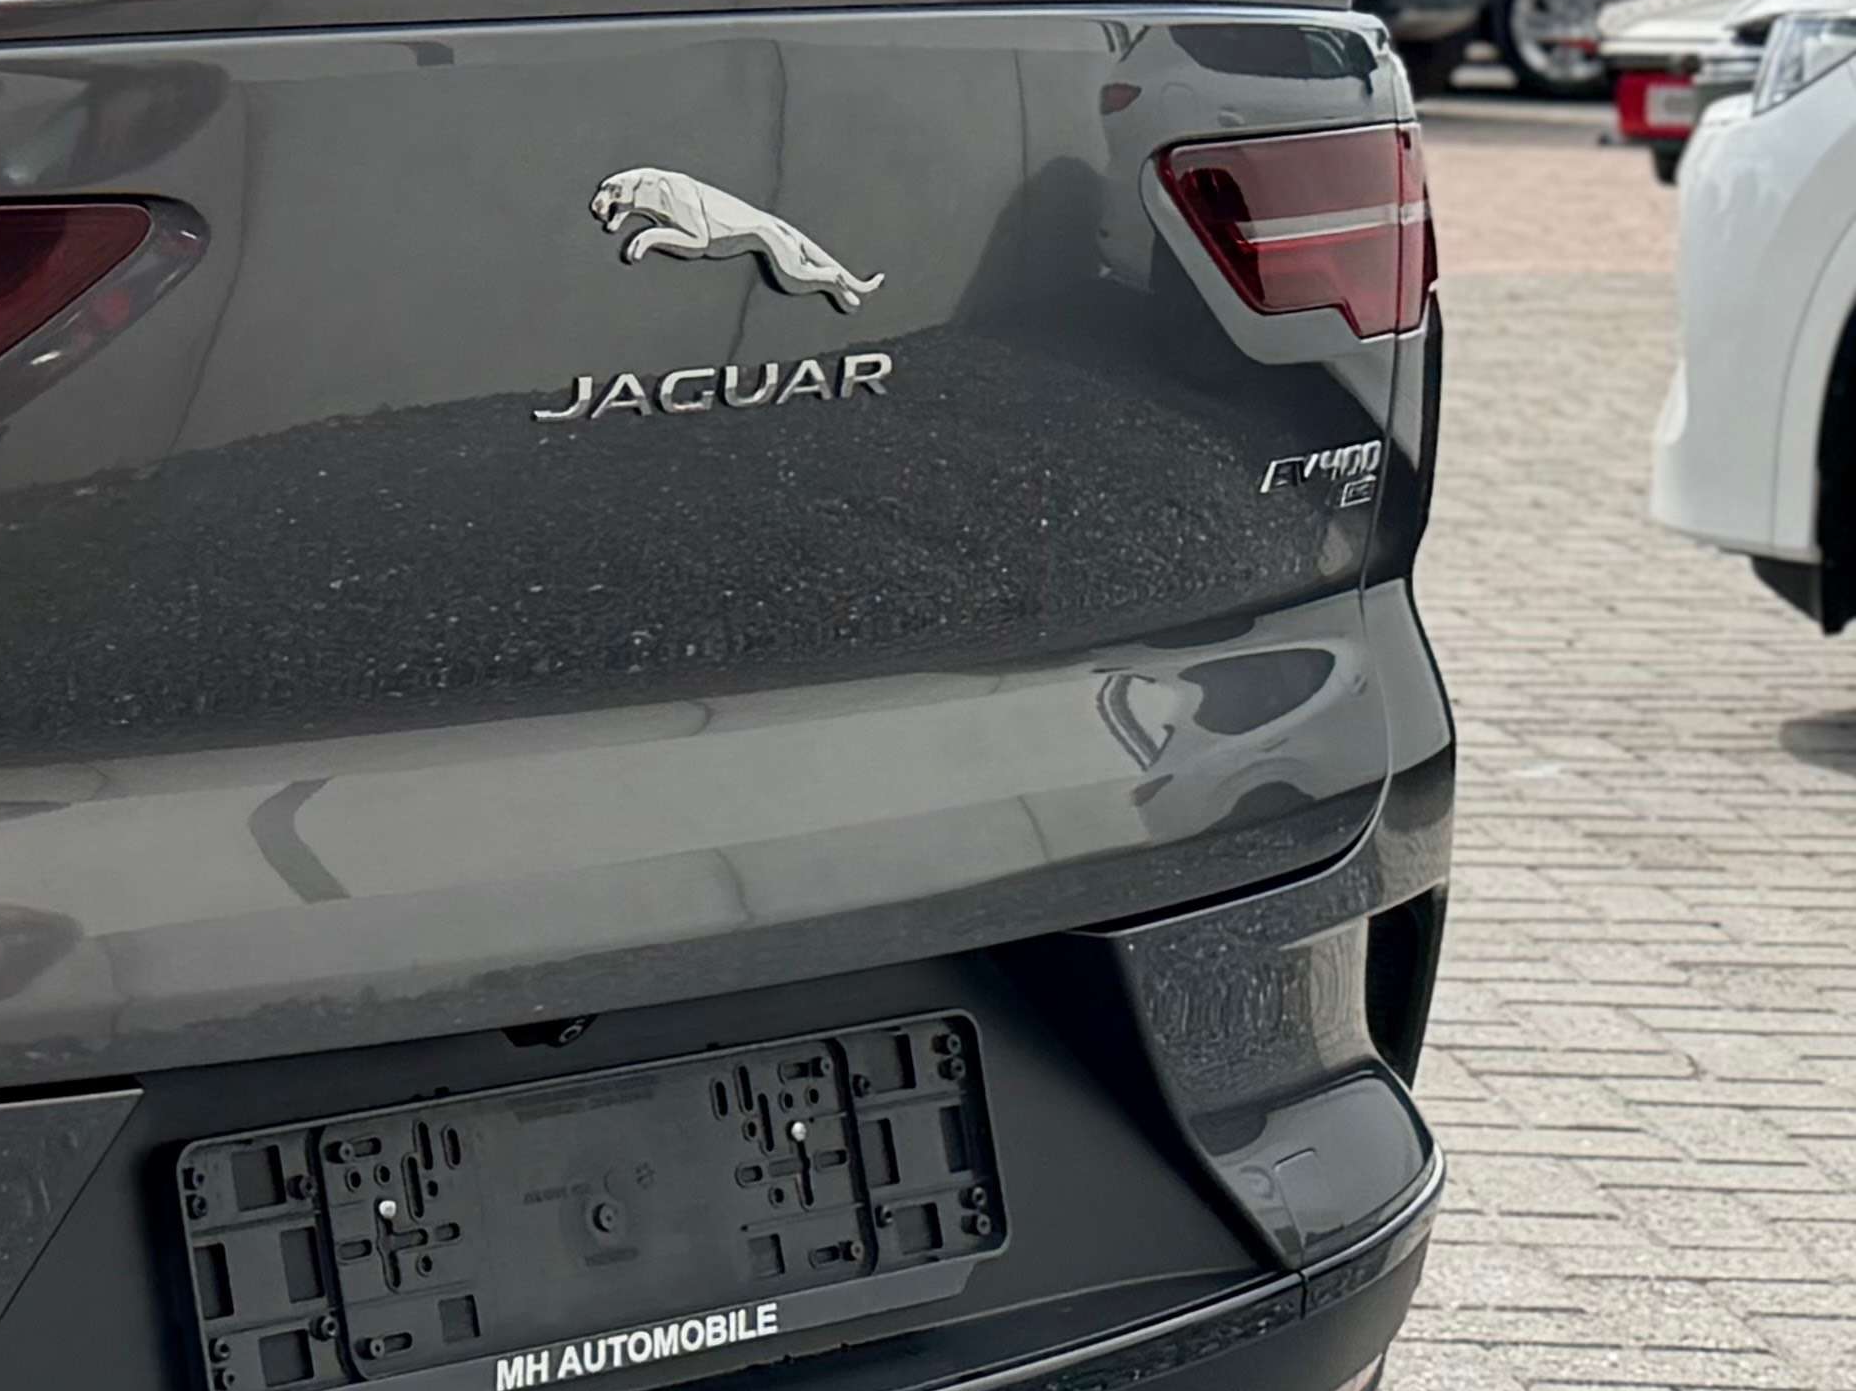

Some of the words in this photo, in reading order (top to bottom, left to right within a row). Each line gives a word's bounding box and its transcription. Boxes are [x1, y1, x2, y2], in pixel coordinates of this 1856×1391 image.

[532, 352, 893, 423] JAGUAR
[1260, 439, 1383, 494] EV400
[556, 1301, 779, 1381] AUTOMOBILE
